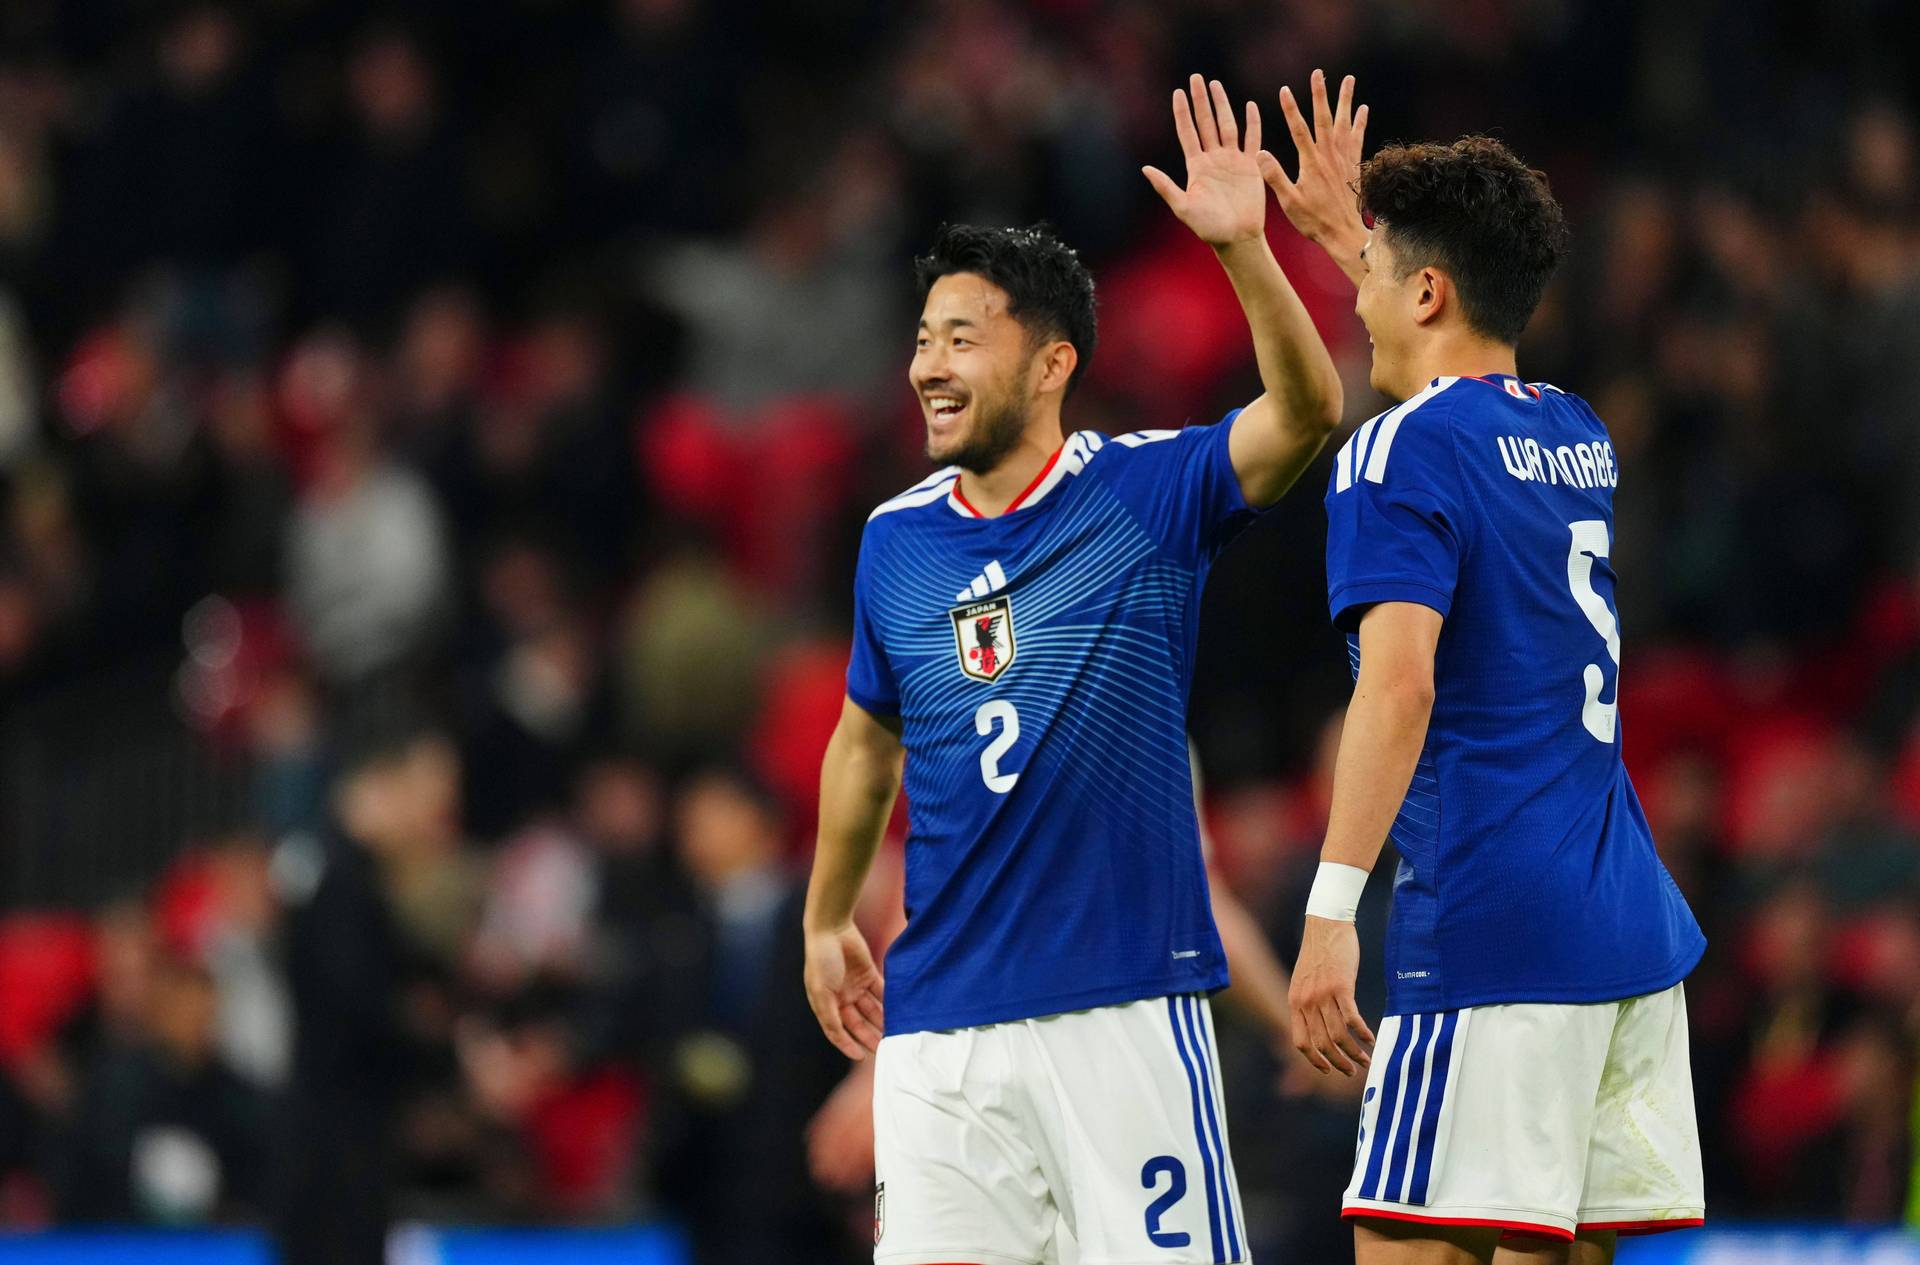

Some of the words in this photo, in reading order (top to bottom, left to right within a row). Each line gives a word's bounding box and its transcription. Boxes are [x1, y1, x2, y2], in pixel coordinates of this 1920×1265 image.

[966, 603, 997, 617] JAPAN
[1567, 520, 1620, 744] 5
[975, 699, 1020, 793] 2
[1141, 1155, 1191, 1248] 2
